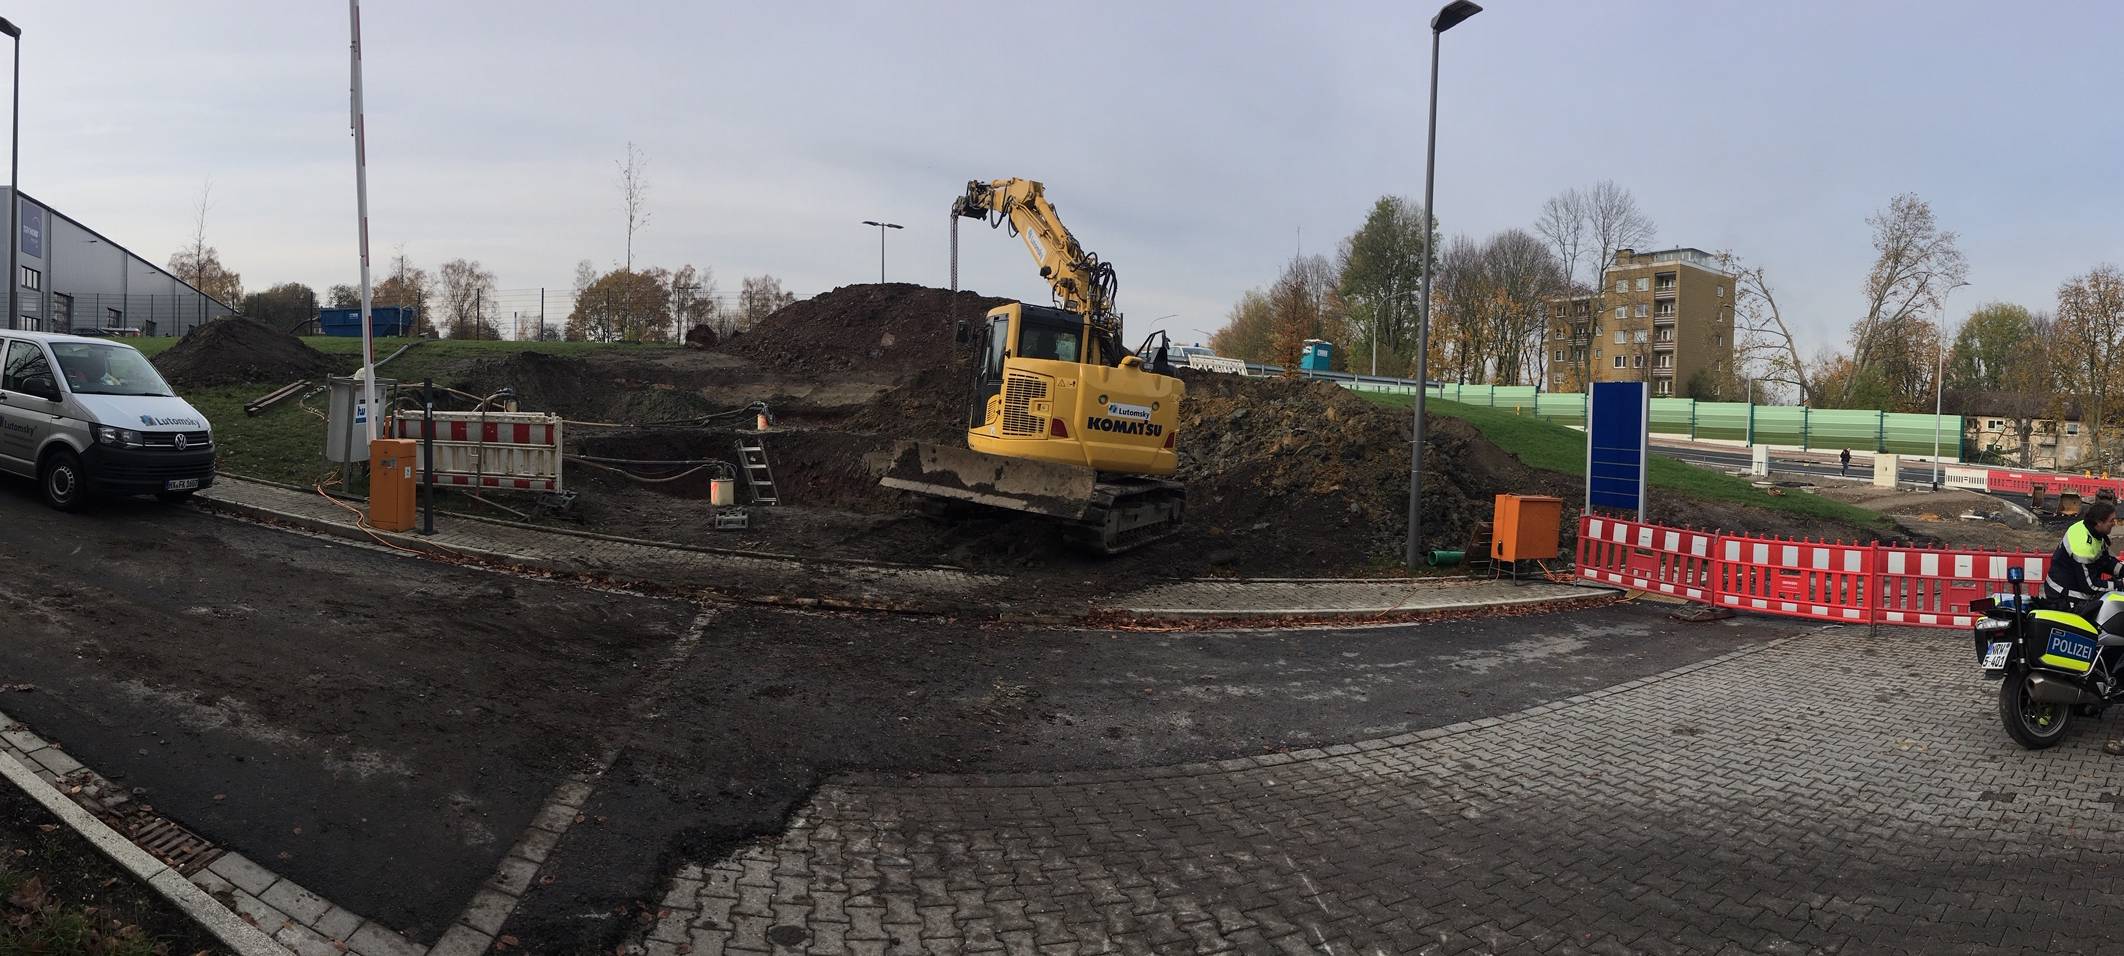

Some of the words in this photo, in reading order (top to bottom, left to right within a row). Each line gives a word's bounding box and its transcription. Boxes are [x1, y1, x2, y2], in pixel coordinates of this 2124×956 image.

[1119, 408, 1150, 419] Lutomsky
[155, 417, 201, 428] Lutomsky
[1087, 416, 1163, 437] KOMATSU
[2052, 638, 2093, 659] POLIZEI
